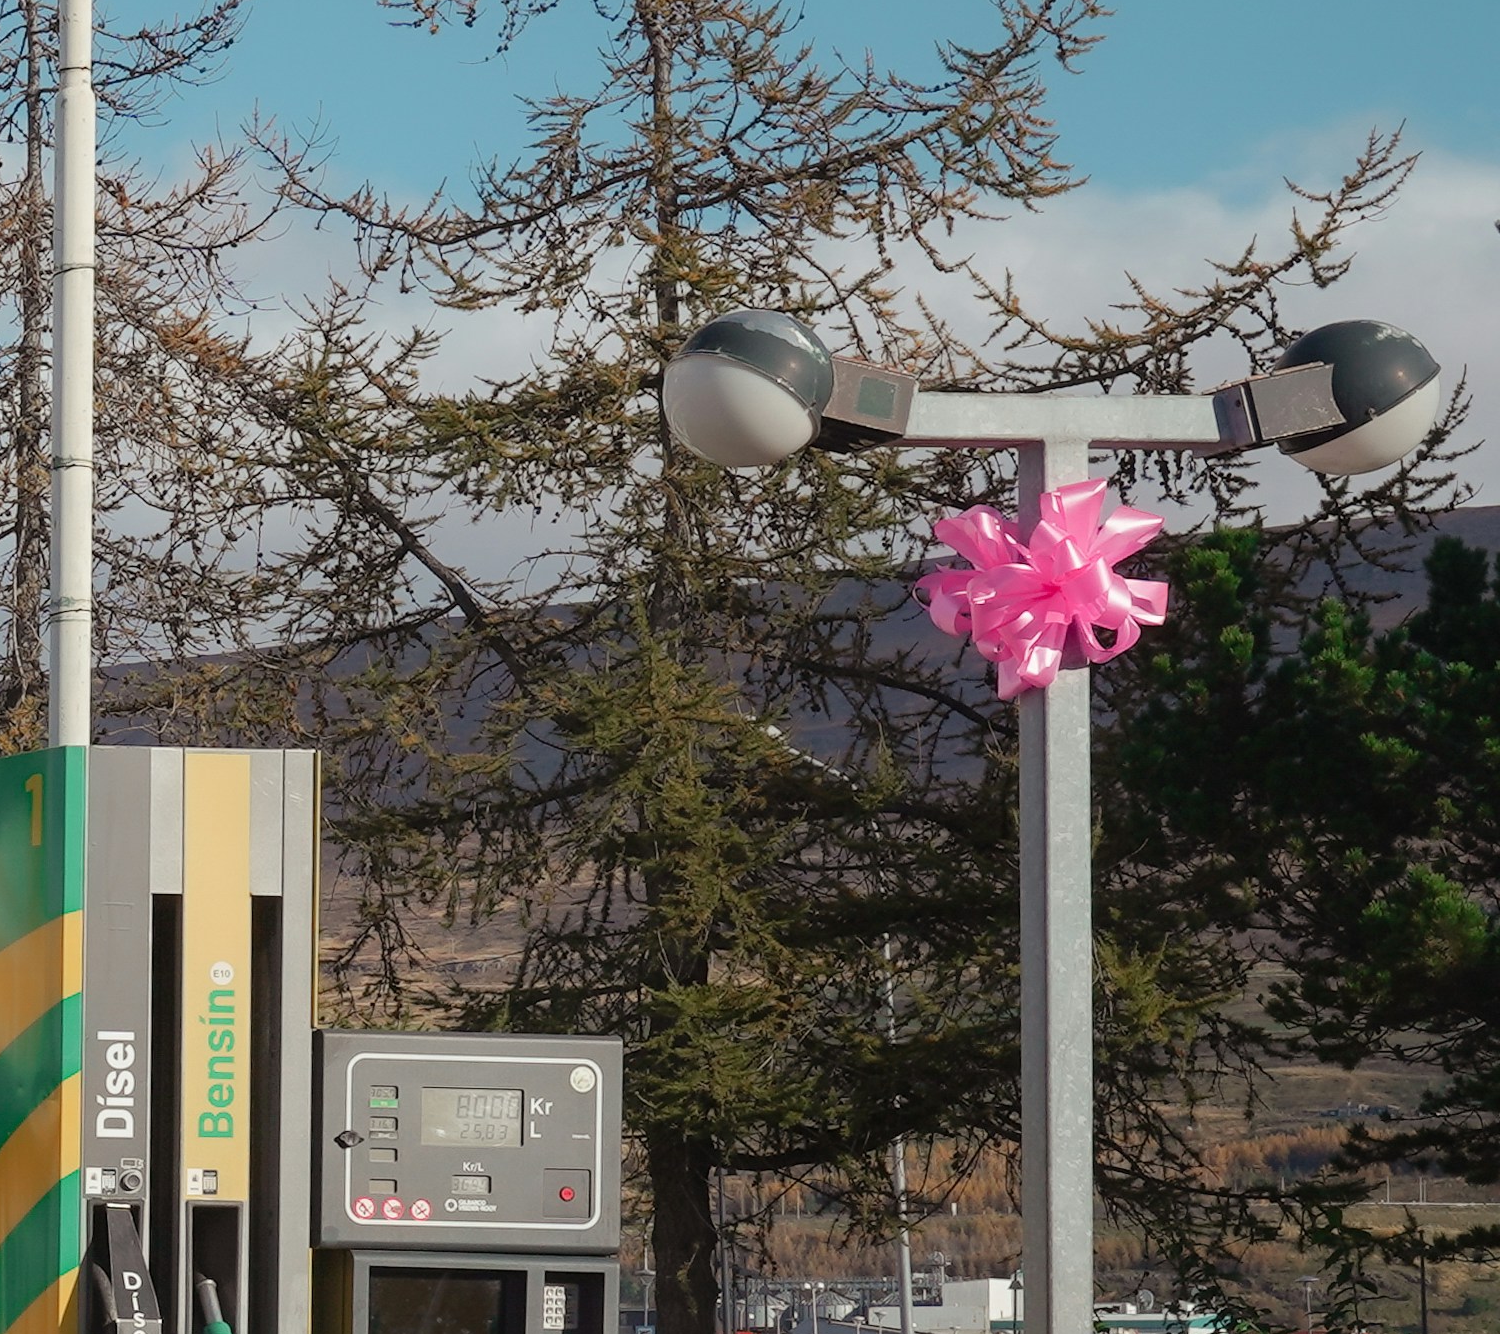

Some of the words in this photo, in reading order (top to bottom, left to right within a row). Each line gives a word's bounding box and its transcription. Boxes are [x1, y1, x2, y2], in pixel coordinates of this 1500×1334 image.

[25, 774, 43, 846] 1
[213, 968, 232, 979] E10
[198, 990, 235, 1138] Bensín
[96, 1031, 136, 1139] Dísel
[530, 1098, 553, 1116] Kr
[530, 1121, 542, 1139] L
[462, 1162, 485, 1172] Kr/L
